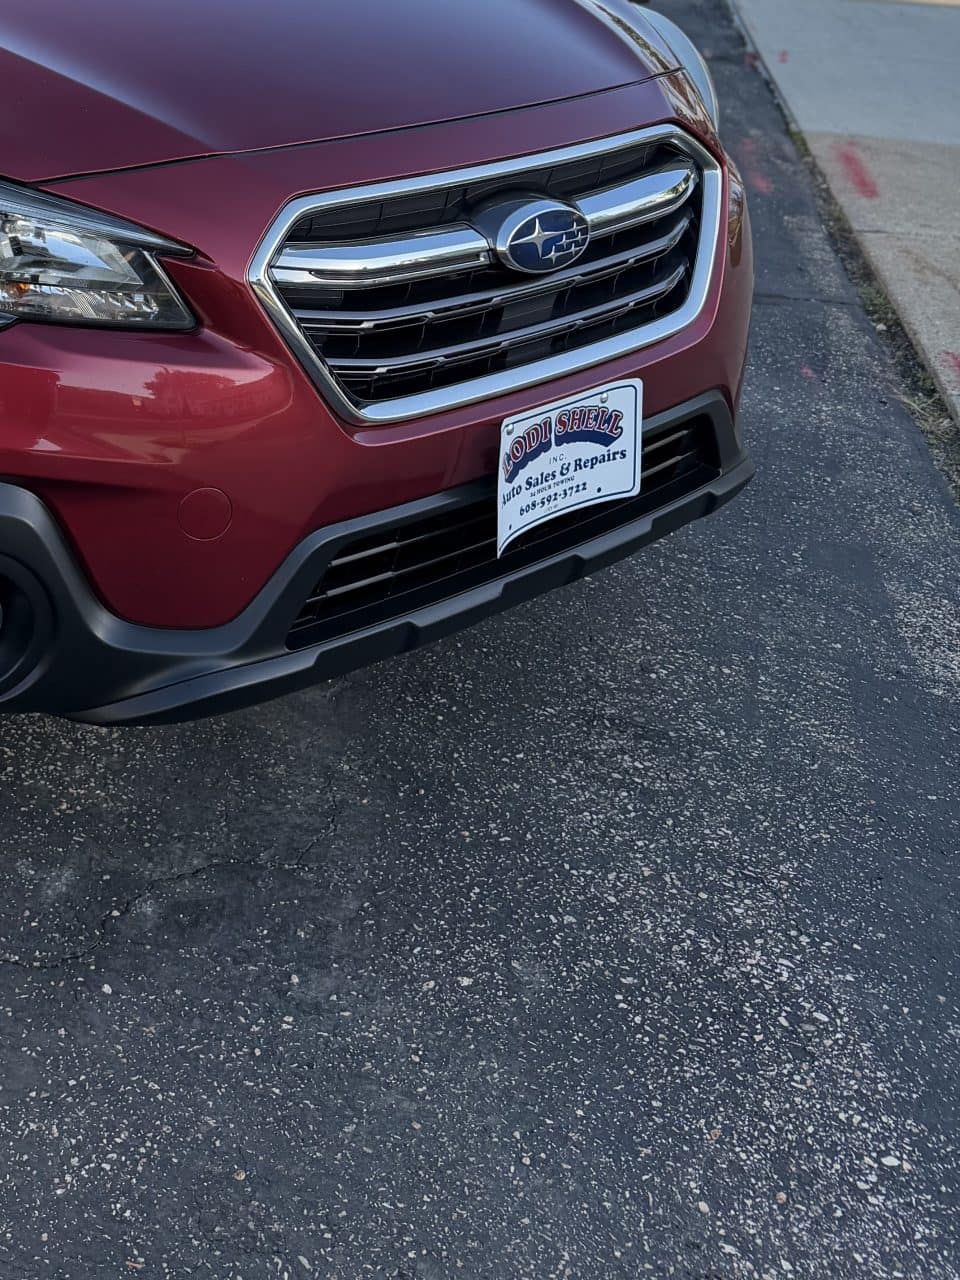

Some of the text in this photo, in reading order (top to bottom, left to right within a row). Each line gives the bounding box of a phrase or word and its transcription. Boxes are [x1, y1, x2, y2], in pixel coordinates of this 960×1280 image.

[502, 406, 624, 481] LODI SHELL
[501, 449, 627, 508] Auto Sales & Repairs
[519, 482, 588, 516] 608-592-3722
